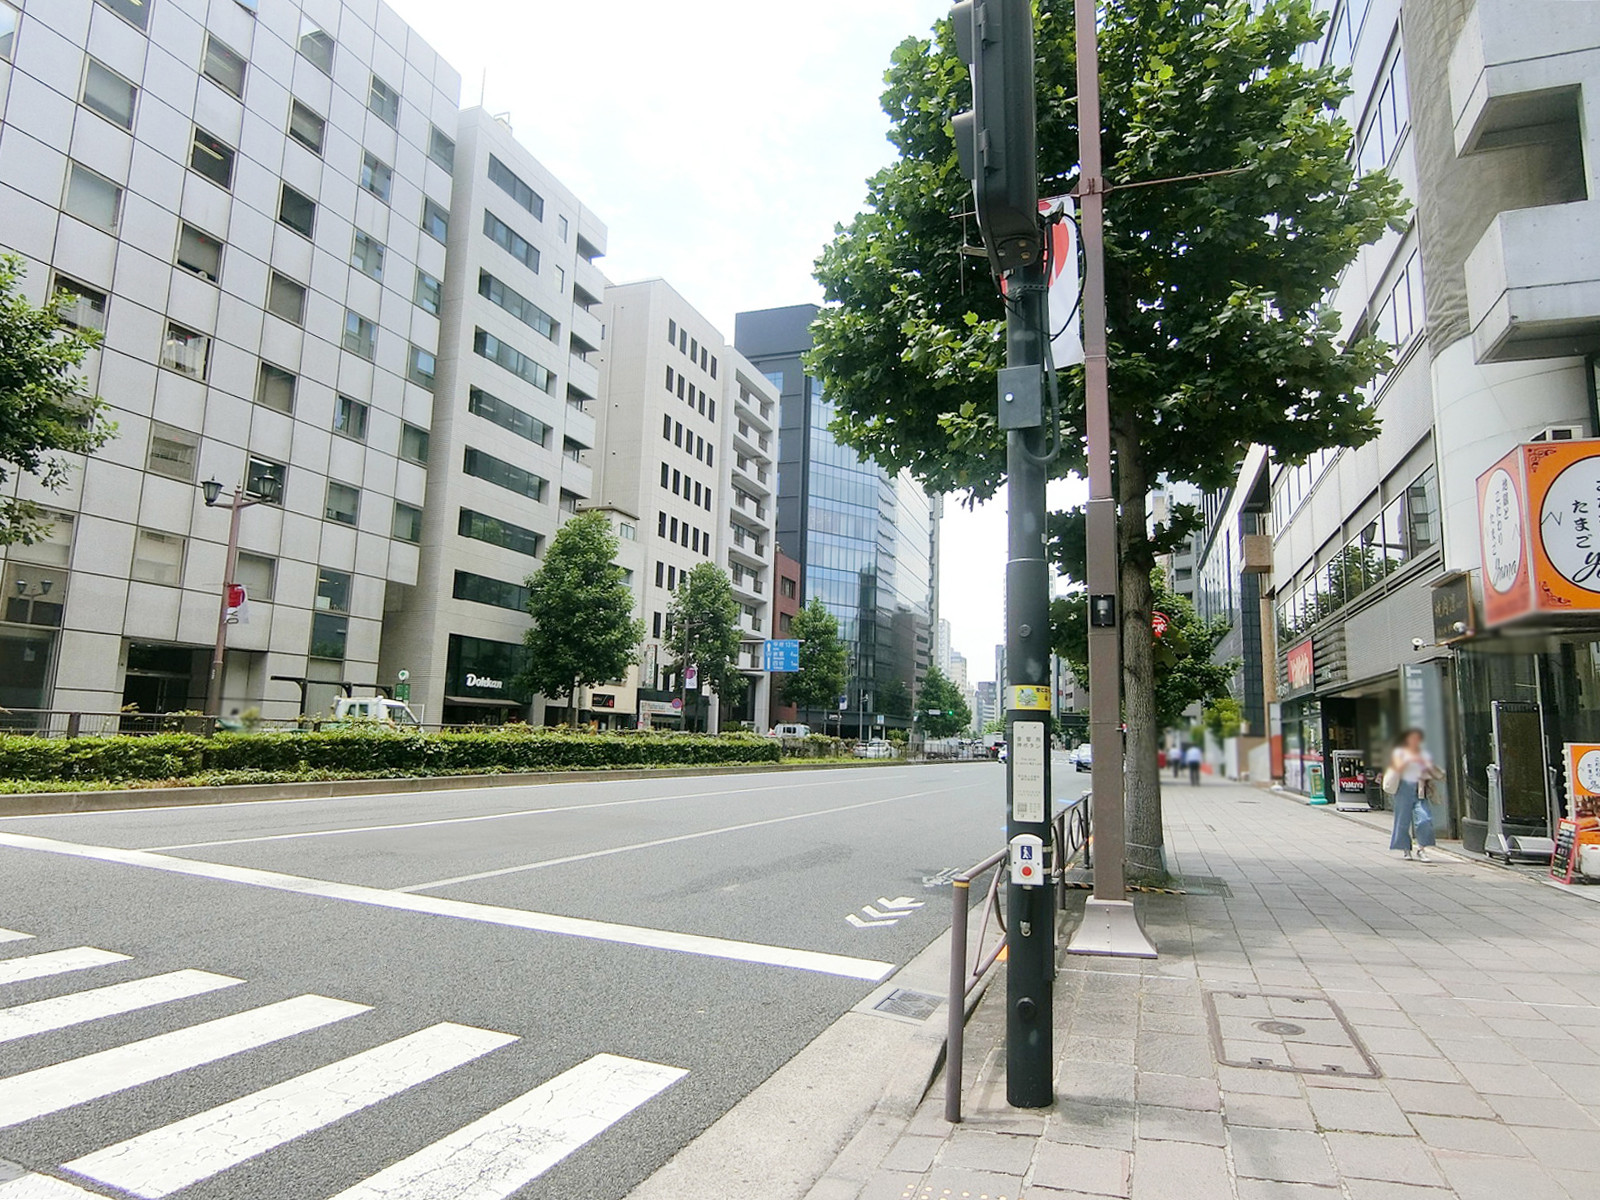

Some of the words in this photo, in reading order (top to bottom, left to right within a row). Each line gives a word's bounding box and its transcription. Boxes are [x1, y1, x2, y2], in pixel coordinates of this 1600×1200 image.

[1572, 499, 1593, 549] たまご
[466, 673, 503, 689] Dokkan
